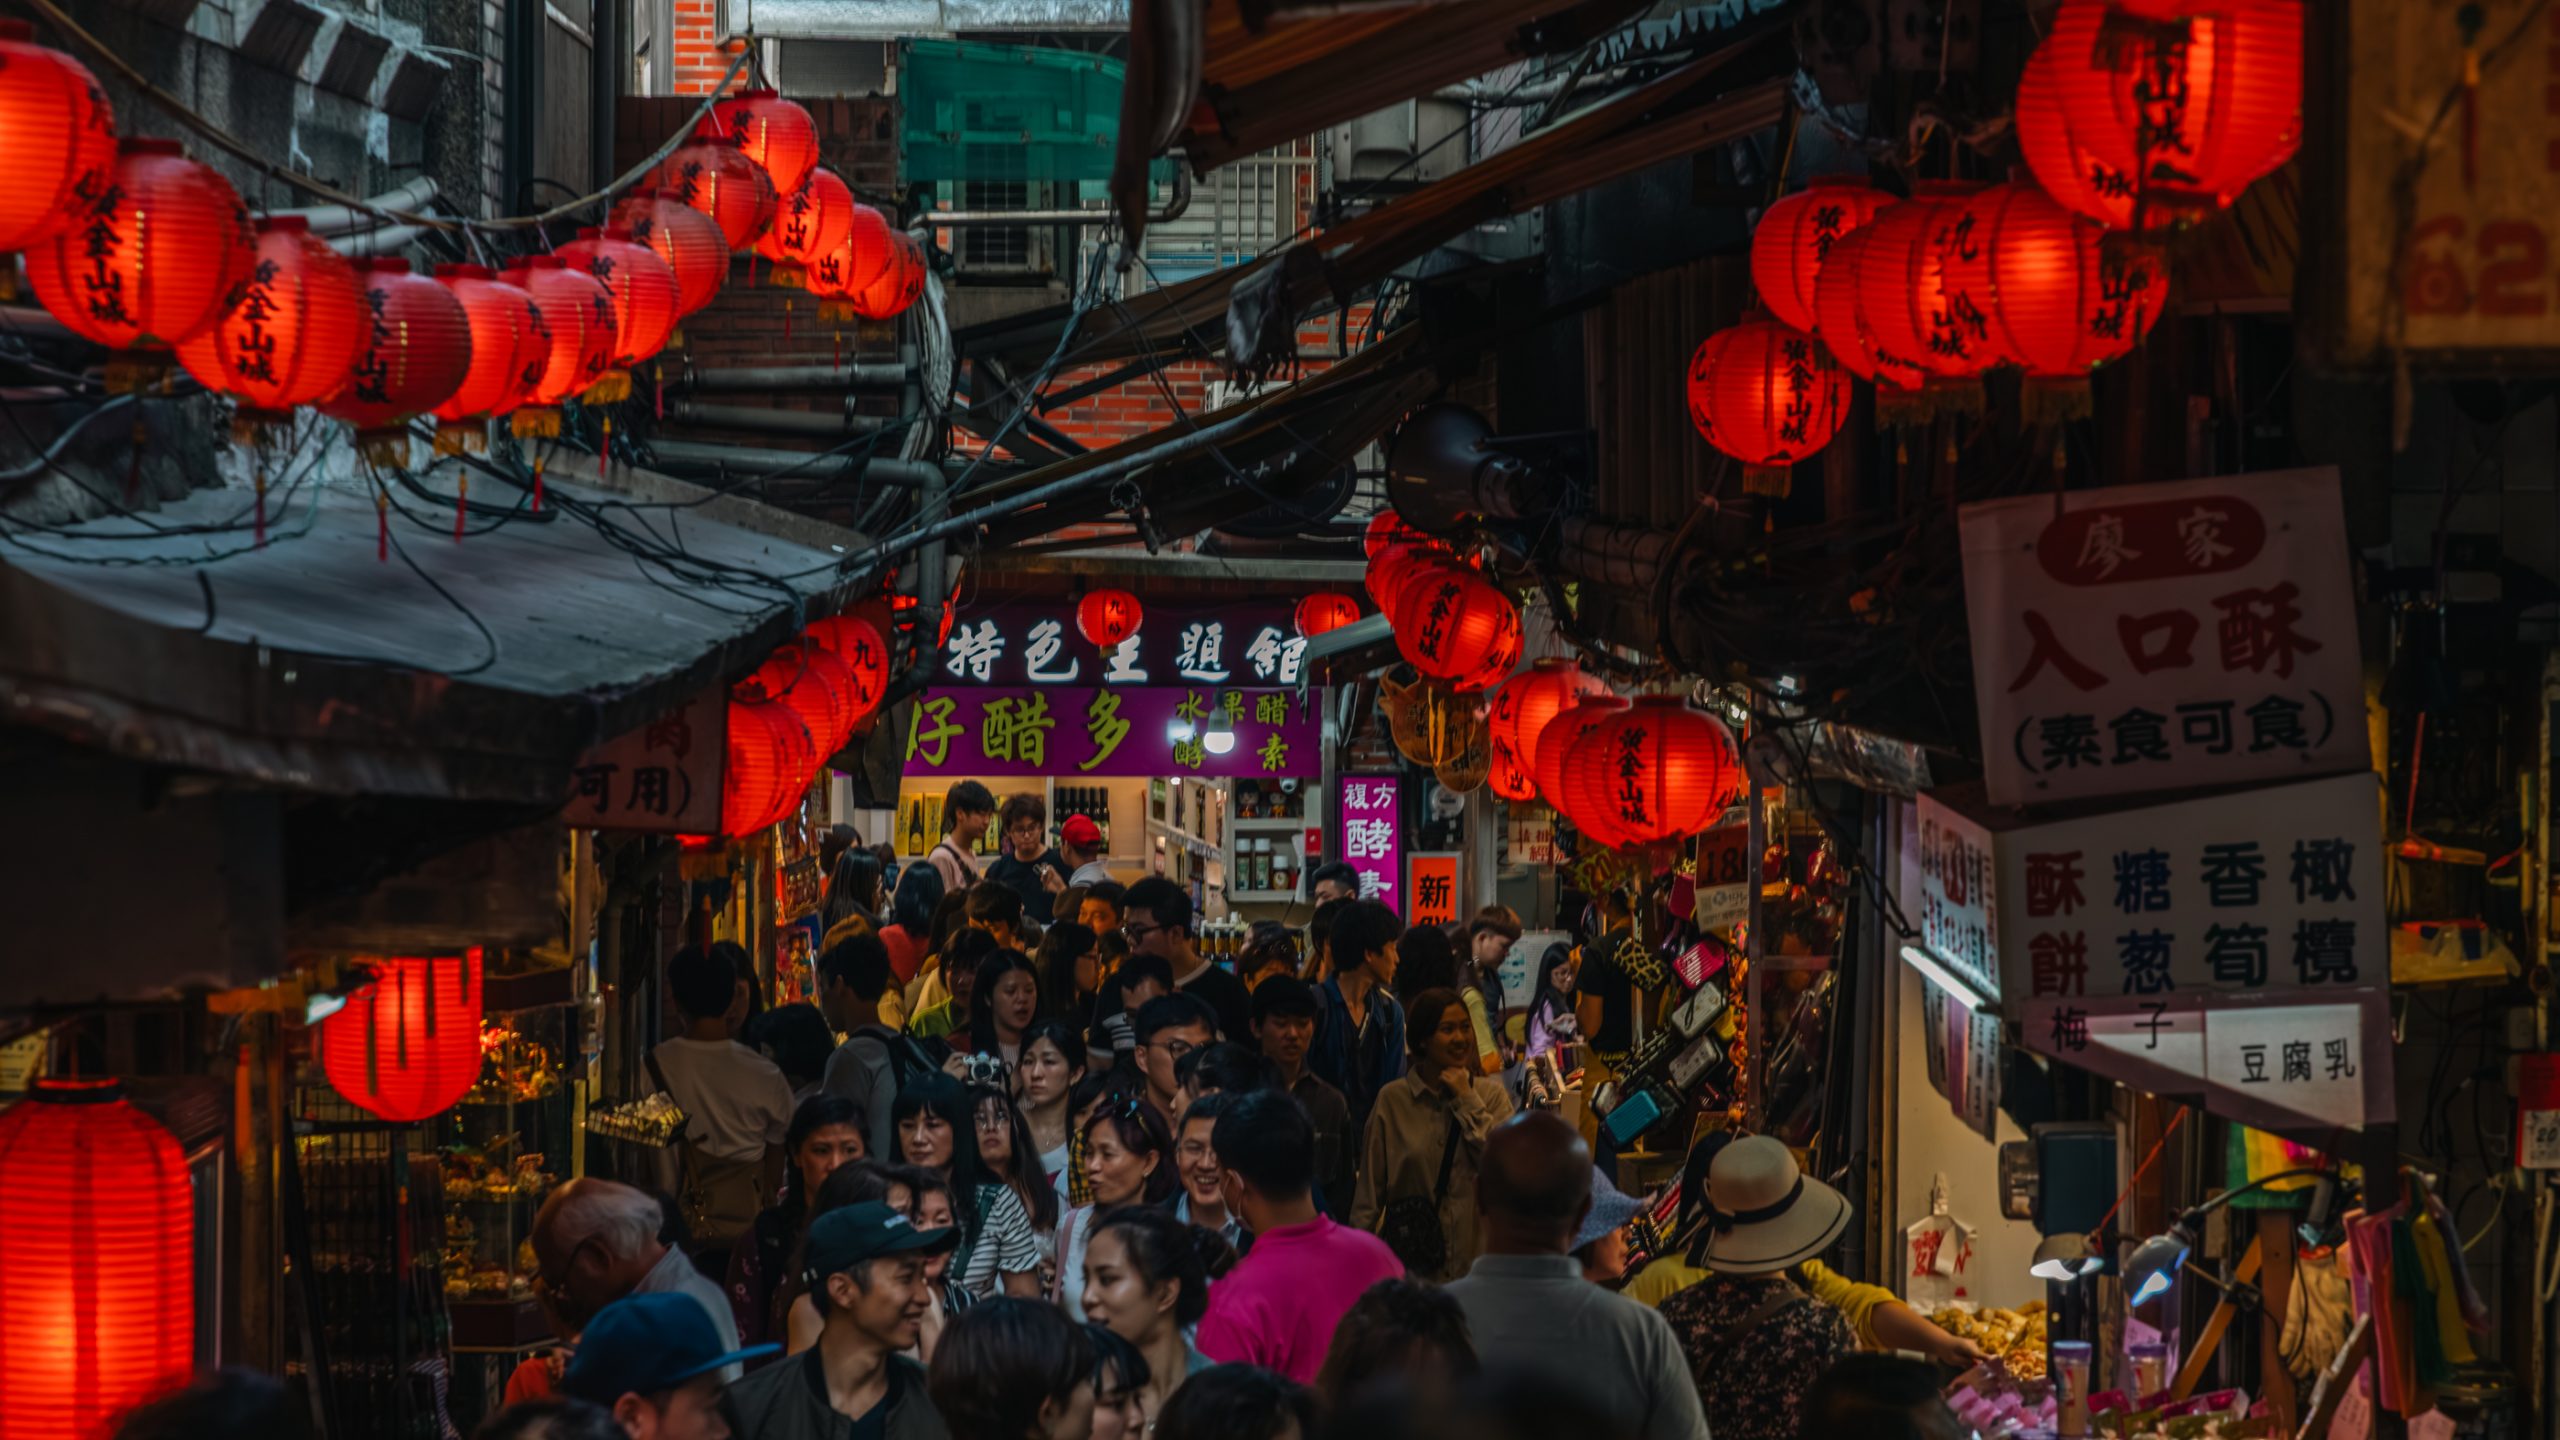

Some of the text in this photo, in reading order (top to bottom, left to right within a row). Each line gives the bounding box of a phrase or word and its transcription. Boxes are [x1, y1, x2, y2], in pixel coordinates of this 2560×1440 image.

[2075, 505, 2237, 581] 廖家
[2006, 581, 2322, 693] 入口酥
[2014, 689, 2335, 774] (素食可食)
[1344, 782, 1397, 811] 複方
[1418, 872, 1452, 926] 新
[2025, 850, 2089, 997] 酥餅
[2240, 1038, 2357, 1084] 豆腐乳
